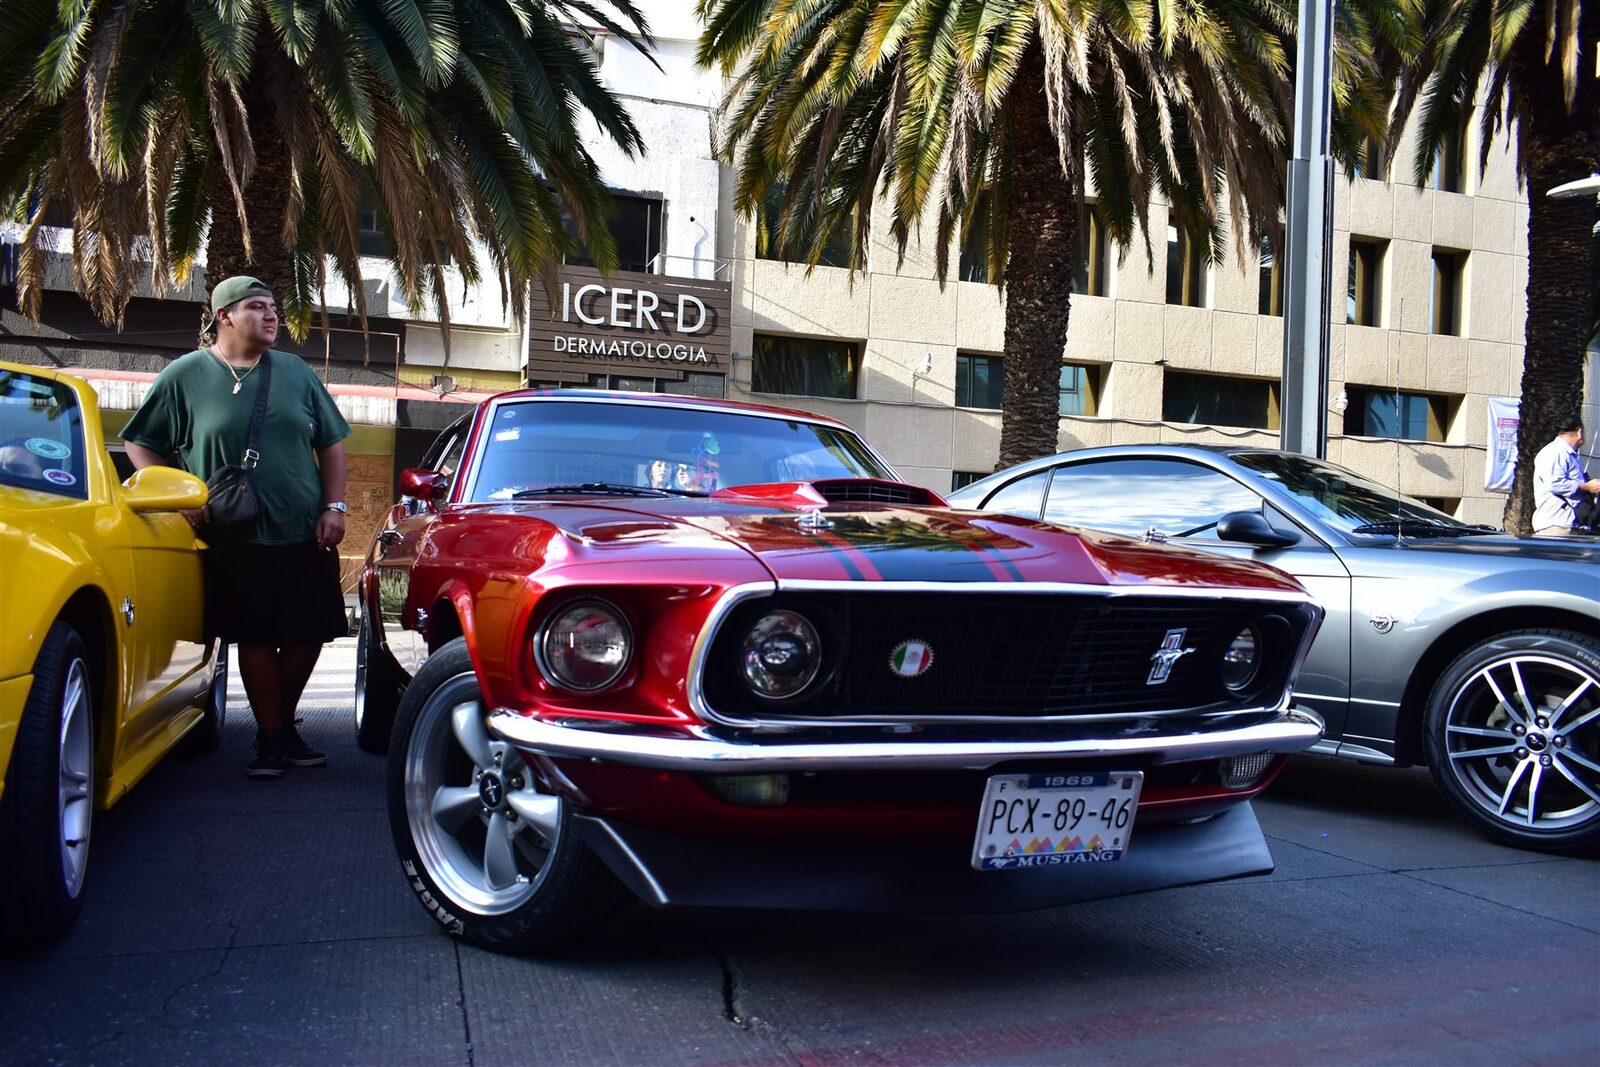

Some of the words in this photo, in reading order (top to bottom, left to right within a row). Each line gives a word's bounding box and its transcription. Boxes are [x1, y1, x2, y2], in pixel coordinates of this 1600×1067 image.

[562, 282, 706, 333] ICER-D
[554, 336, 707, 362] DERMATOLOGIA
[1000, 782, 1007, 793] F
[1044, 776, 1094, 787] 1969
[989, 798, 1132, 835] PCX-89-46
[1017, 850, 1114, 867] MUSTANG
